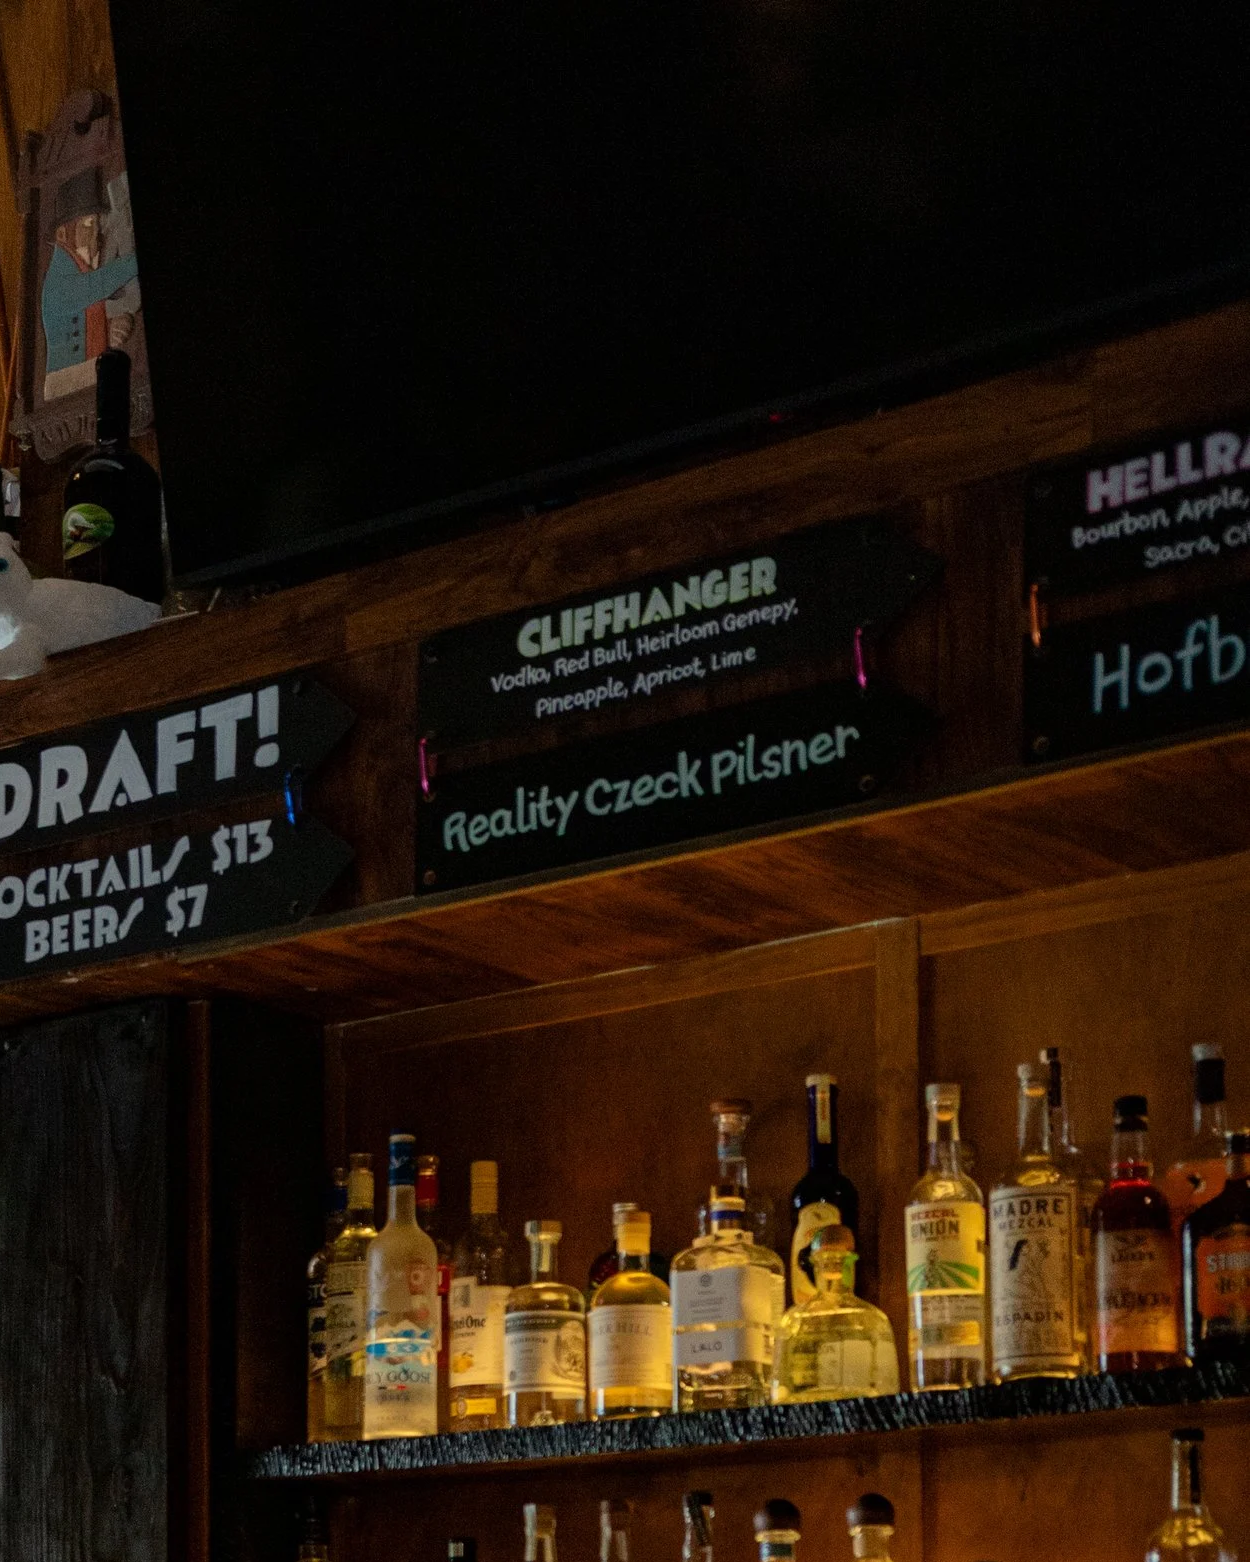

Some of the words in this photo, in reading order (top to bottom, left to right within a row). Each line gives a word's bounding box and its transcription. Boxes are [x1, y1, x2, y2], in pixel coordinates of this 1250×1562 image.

[516, 554, 779, 660] CLIFFHANGER
[490, 663, 552, 695] Vodka,
[553, 649, 591, 680] Red
[593, 637, 634, 669] Bull,
[635, 618, 721, 659] Heirloom
[533, 678, 630, 719] Pineapple,
[632, 656, 707, 698] Apricot,
[710, 645, 757, 674] Lime
[441, 785, 579, 853] Reality
[584, 750, 705, 818] Czeck
[710, 723, 862, 795] Pilsner
[210, 818, 276, 877] $13
[23, 896, 145, 965] BEERS
[164, 882, 210, 939] $7
[993, 1198, 1064, 1219] MADRE
